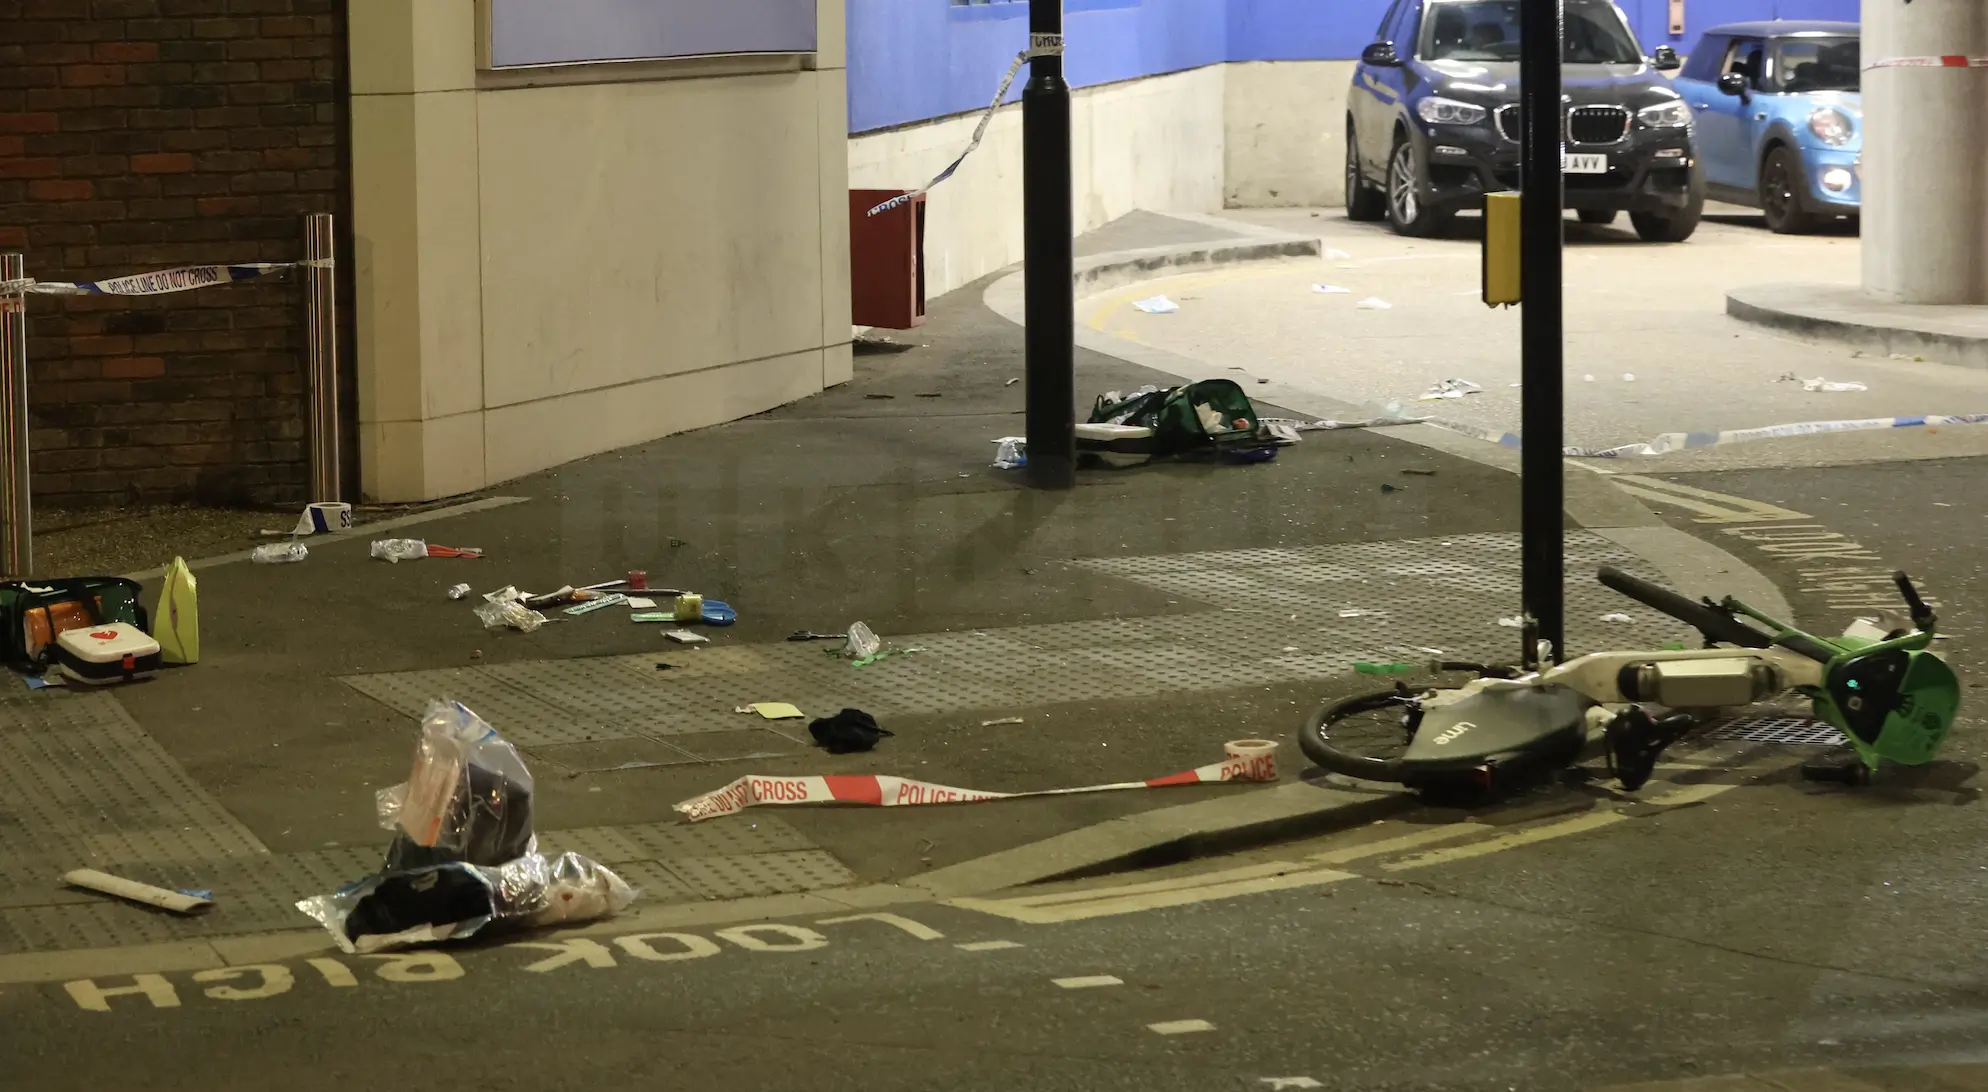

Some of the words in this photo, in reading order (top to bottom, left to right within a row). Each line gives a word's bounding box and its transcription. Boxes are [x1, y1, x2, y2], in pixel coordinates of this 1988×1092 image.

[108, 279, 139, 294] POLICE
[136, 276, 157, 293] LINE
[155, 273, 169, 290] DO
[169, 270, 187, 288] NOT
[188, 266, 218, 286] CROSS
[751, 779, 808, 802] CROSS
[506, 912, 946, 973] LOOK
